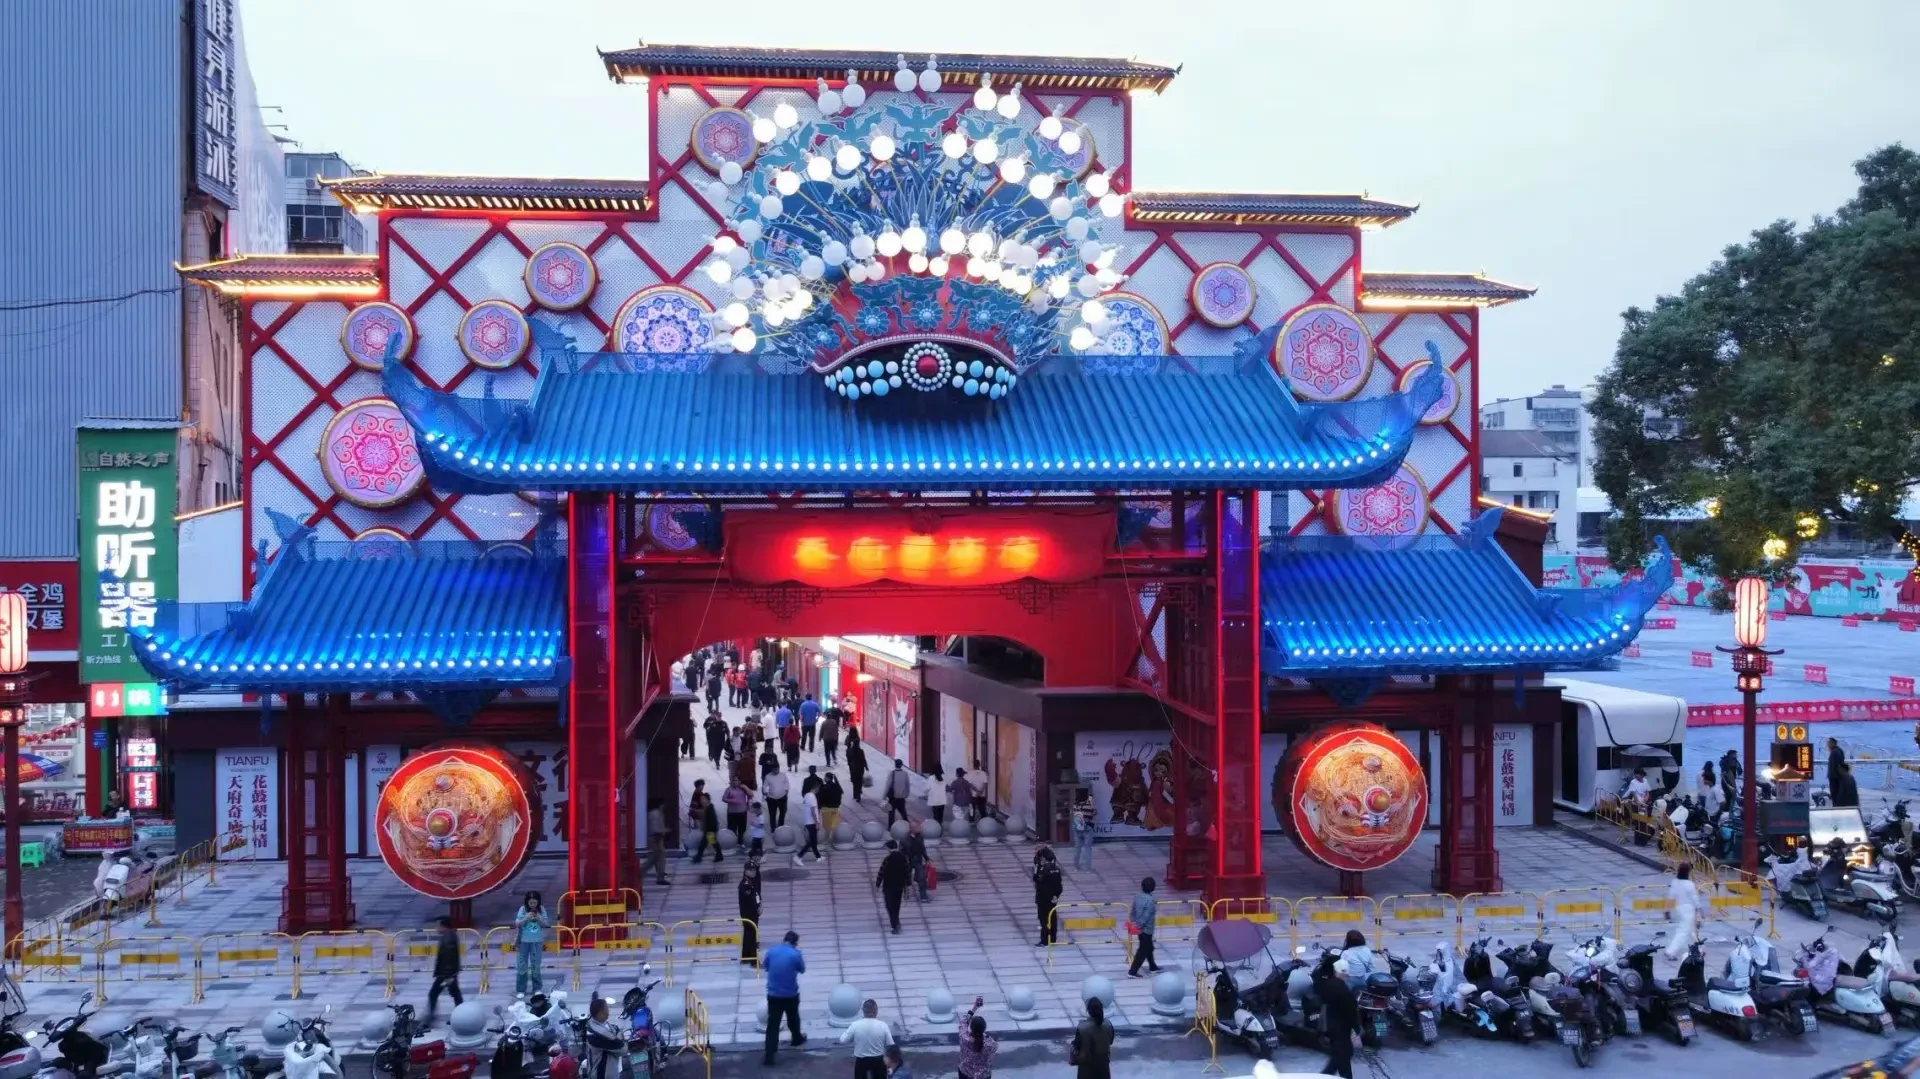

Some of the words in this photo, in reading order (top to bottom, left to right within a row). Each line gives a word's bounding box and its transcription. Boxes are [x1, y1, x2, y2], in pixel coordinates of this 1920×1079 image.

[100, 452, 169, 467] 自然之声
[97, 480, 158, 628] 助听器
[0, 583, 64, 604] 全鸡
[225, 756, 270, 766] TIANFU
[1501, 748, 1516, 816] 花鼓梨园情
[252, 774, 268, 848] 花鼓梨园情
